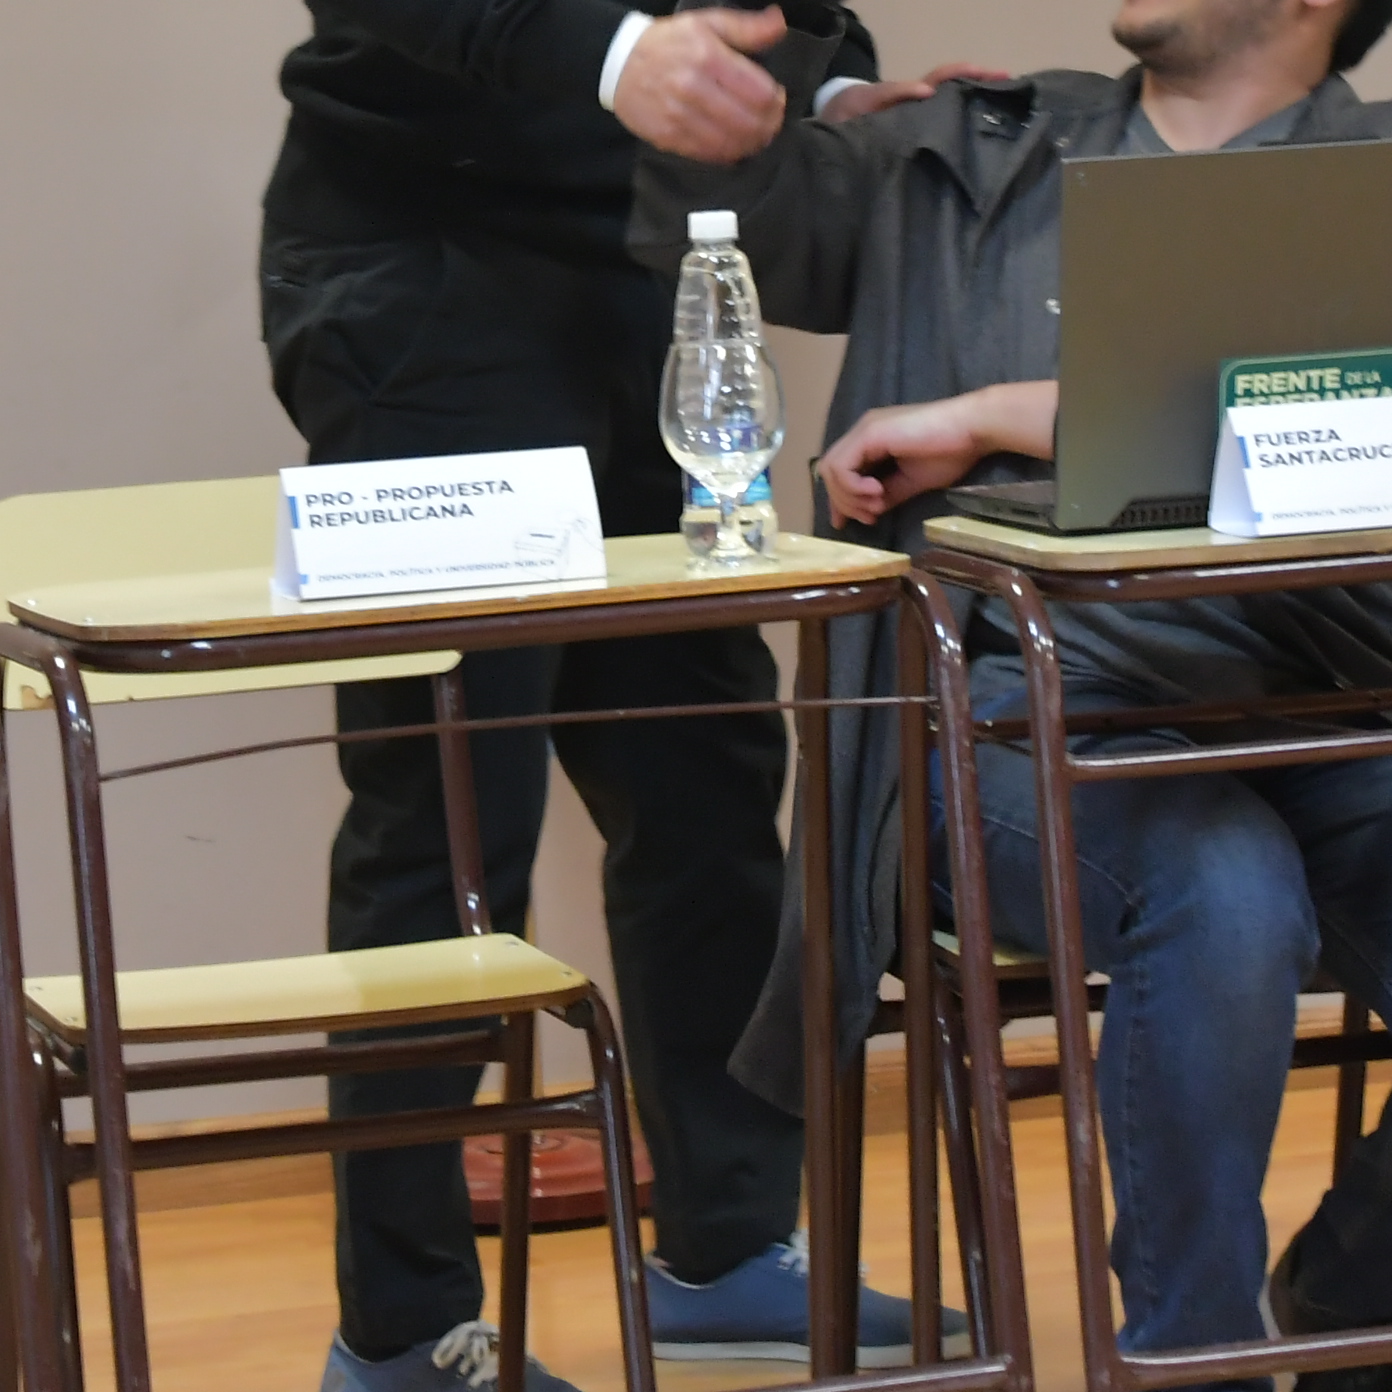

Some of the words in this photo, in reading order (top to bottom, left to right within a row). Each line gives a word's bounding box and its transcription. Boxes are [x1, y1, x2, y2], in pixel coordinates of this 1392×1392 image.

[1235, 367, 1341, 396] FRENTE
[1254, 429, 1342, 448] FUERZA
[306, 492, 354, 508] PRO
[376, 480, 514, 503] PROPUESTA
[308, 503, 474, 528] REPUBLICANA
